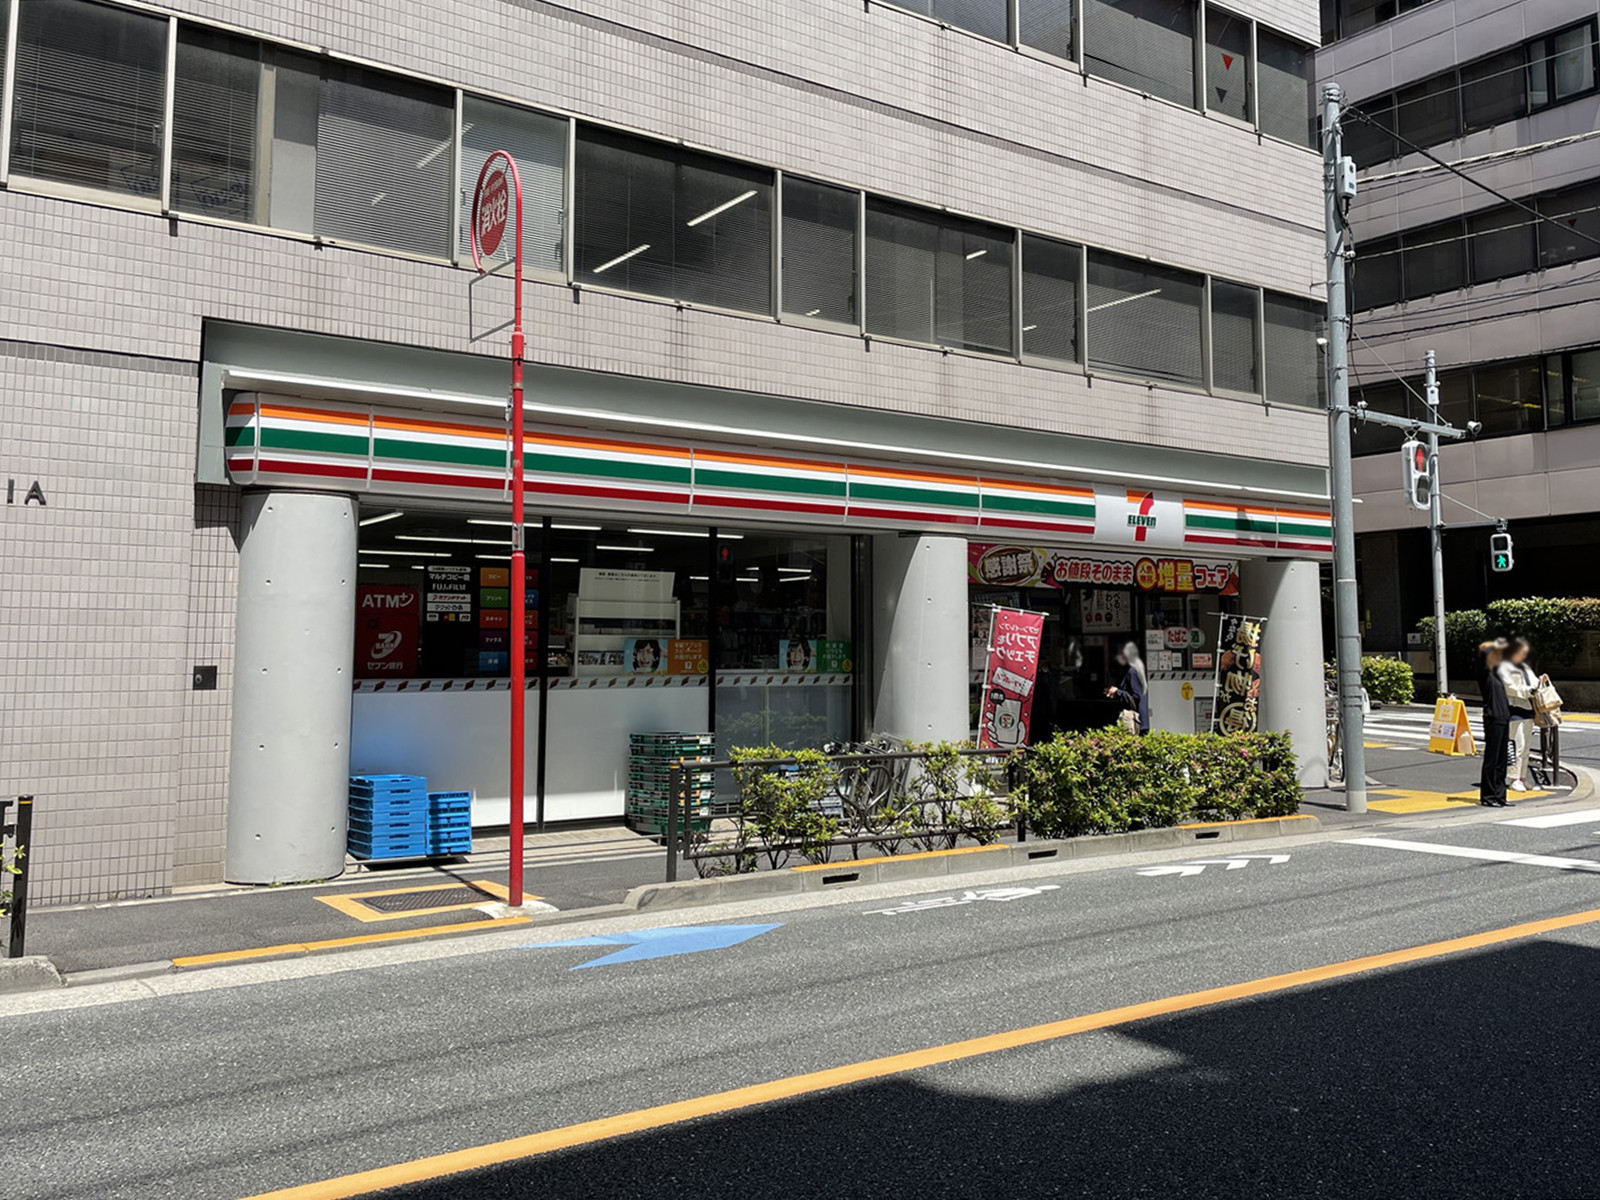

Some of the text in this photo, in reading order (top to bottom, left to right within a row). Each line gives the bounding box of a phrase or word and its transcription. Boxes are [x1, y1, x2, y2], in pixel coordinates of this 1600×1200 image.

[481, 189, 507, 237] 消火栓
[984, 552, 1032, 578] 感謝祭
[1056, 561, 1133, 583] お値段そのまま
[1167, 630, 1188, 643] たばこ
